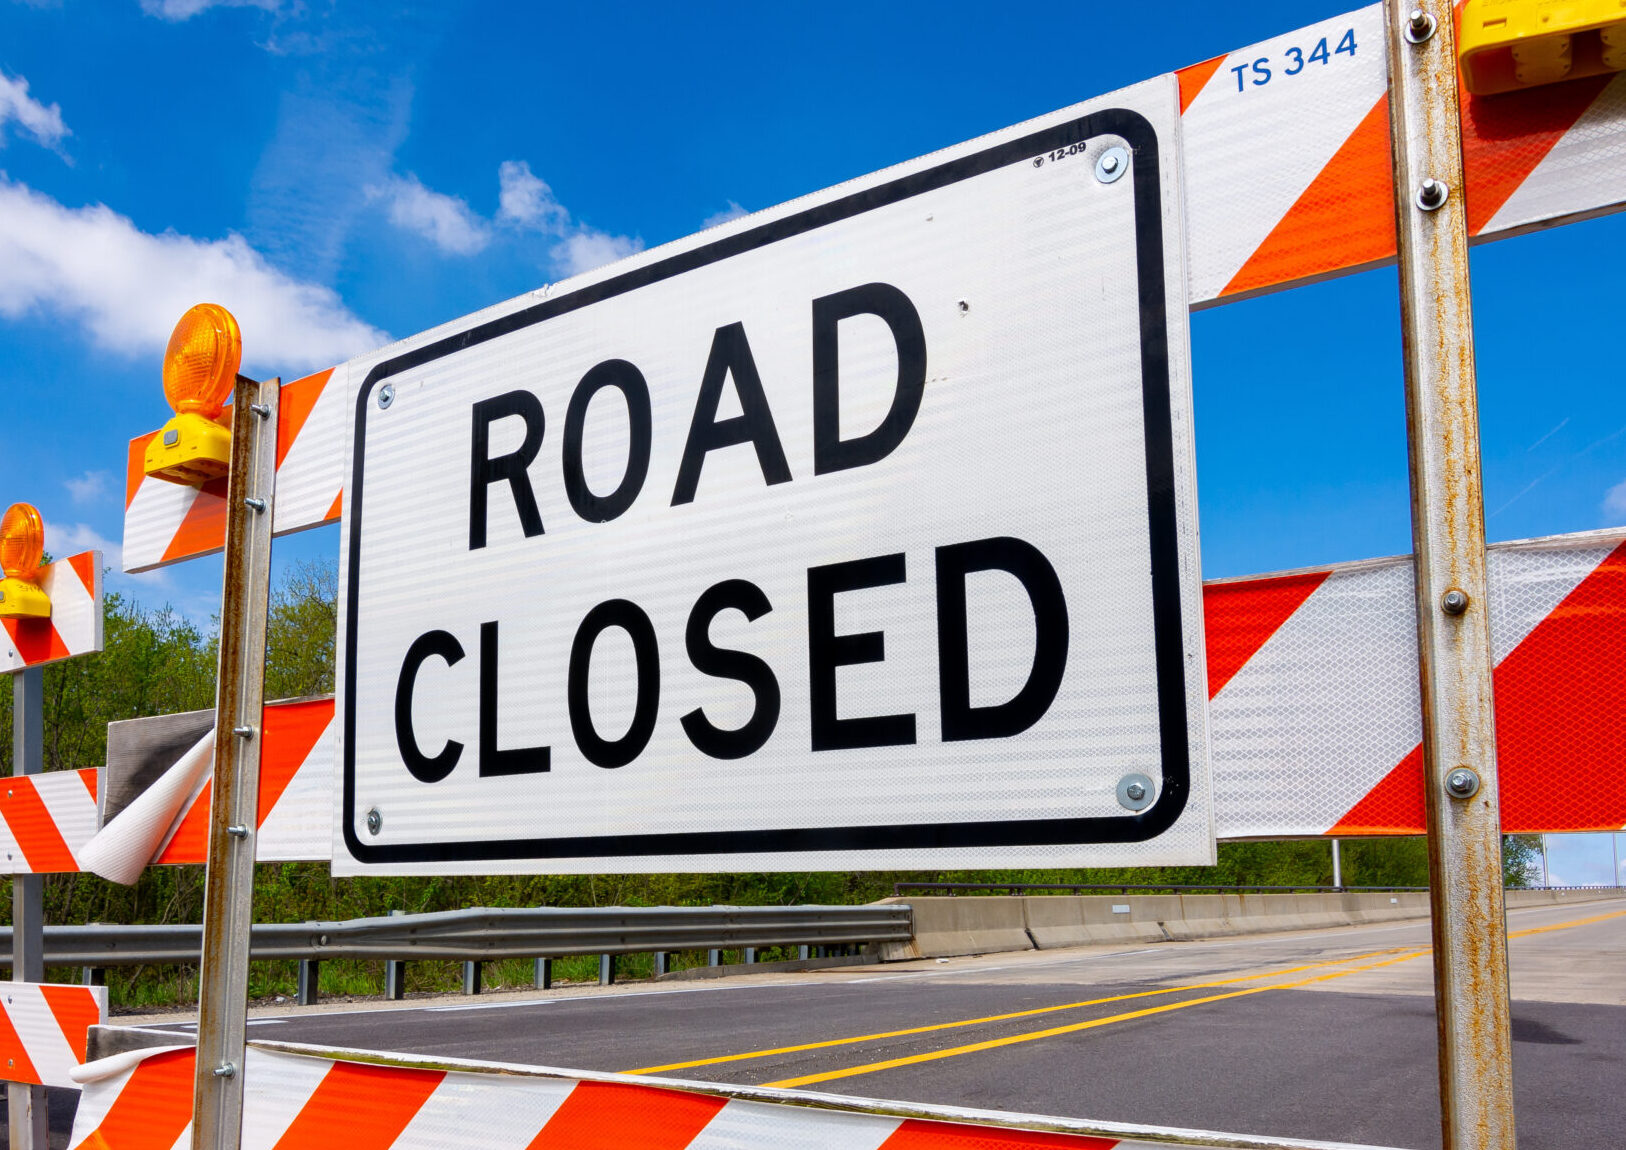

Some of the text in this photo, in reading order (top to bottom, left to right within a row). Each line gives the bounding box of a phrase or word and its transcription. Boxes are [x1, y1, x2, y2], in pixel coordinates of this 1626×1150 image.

[1230, 28, 1358, 93] TS 344
[1048, 142, 1087, 162] 12-09
[470, 282, 927, 551] ROAD
[394, 536, 1070, 784] CLOSED
